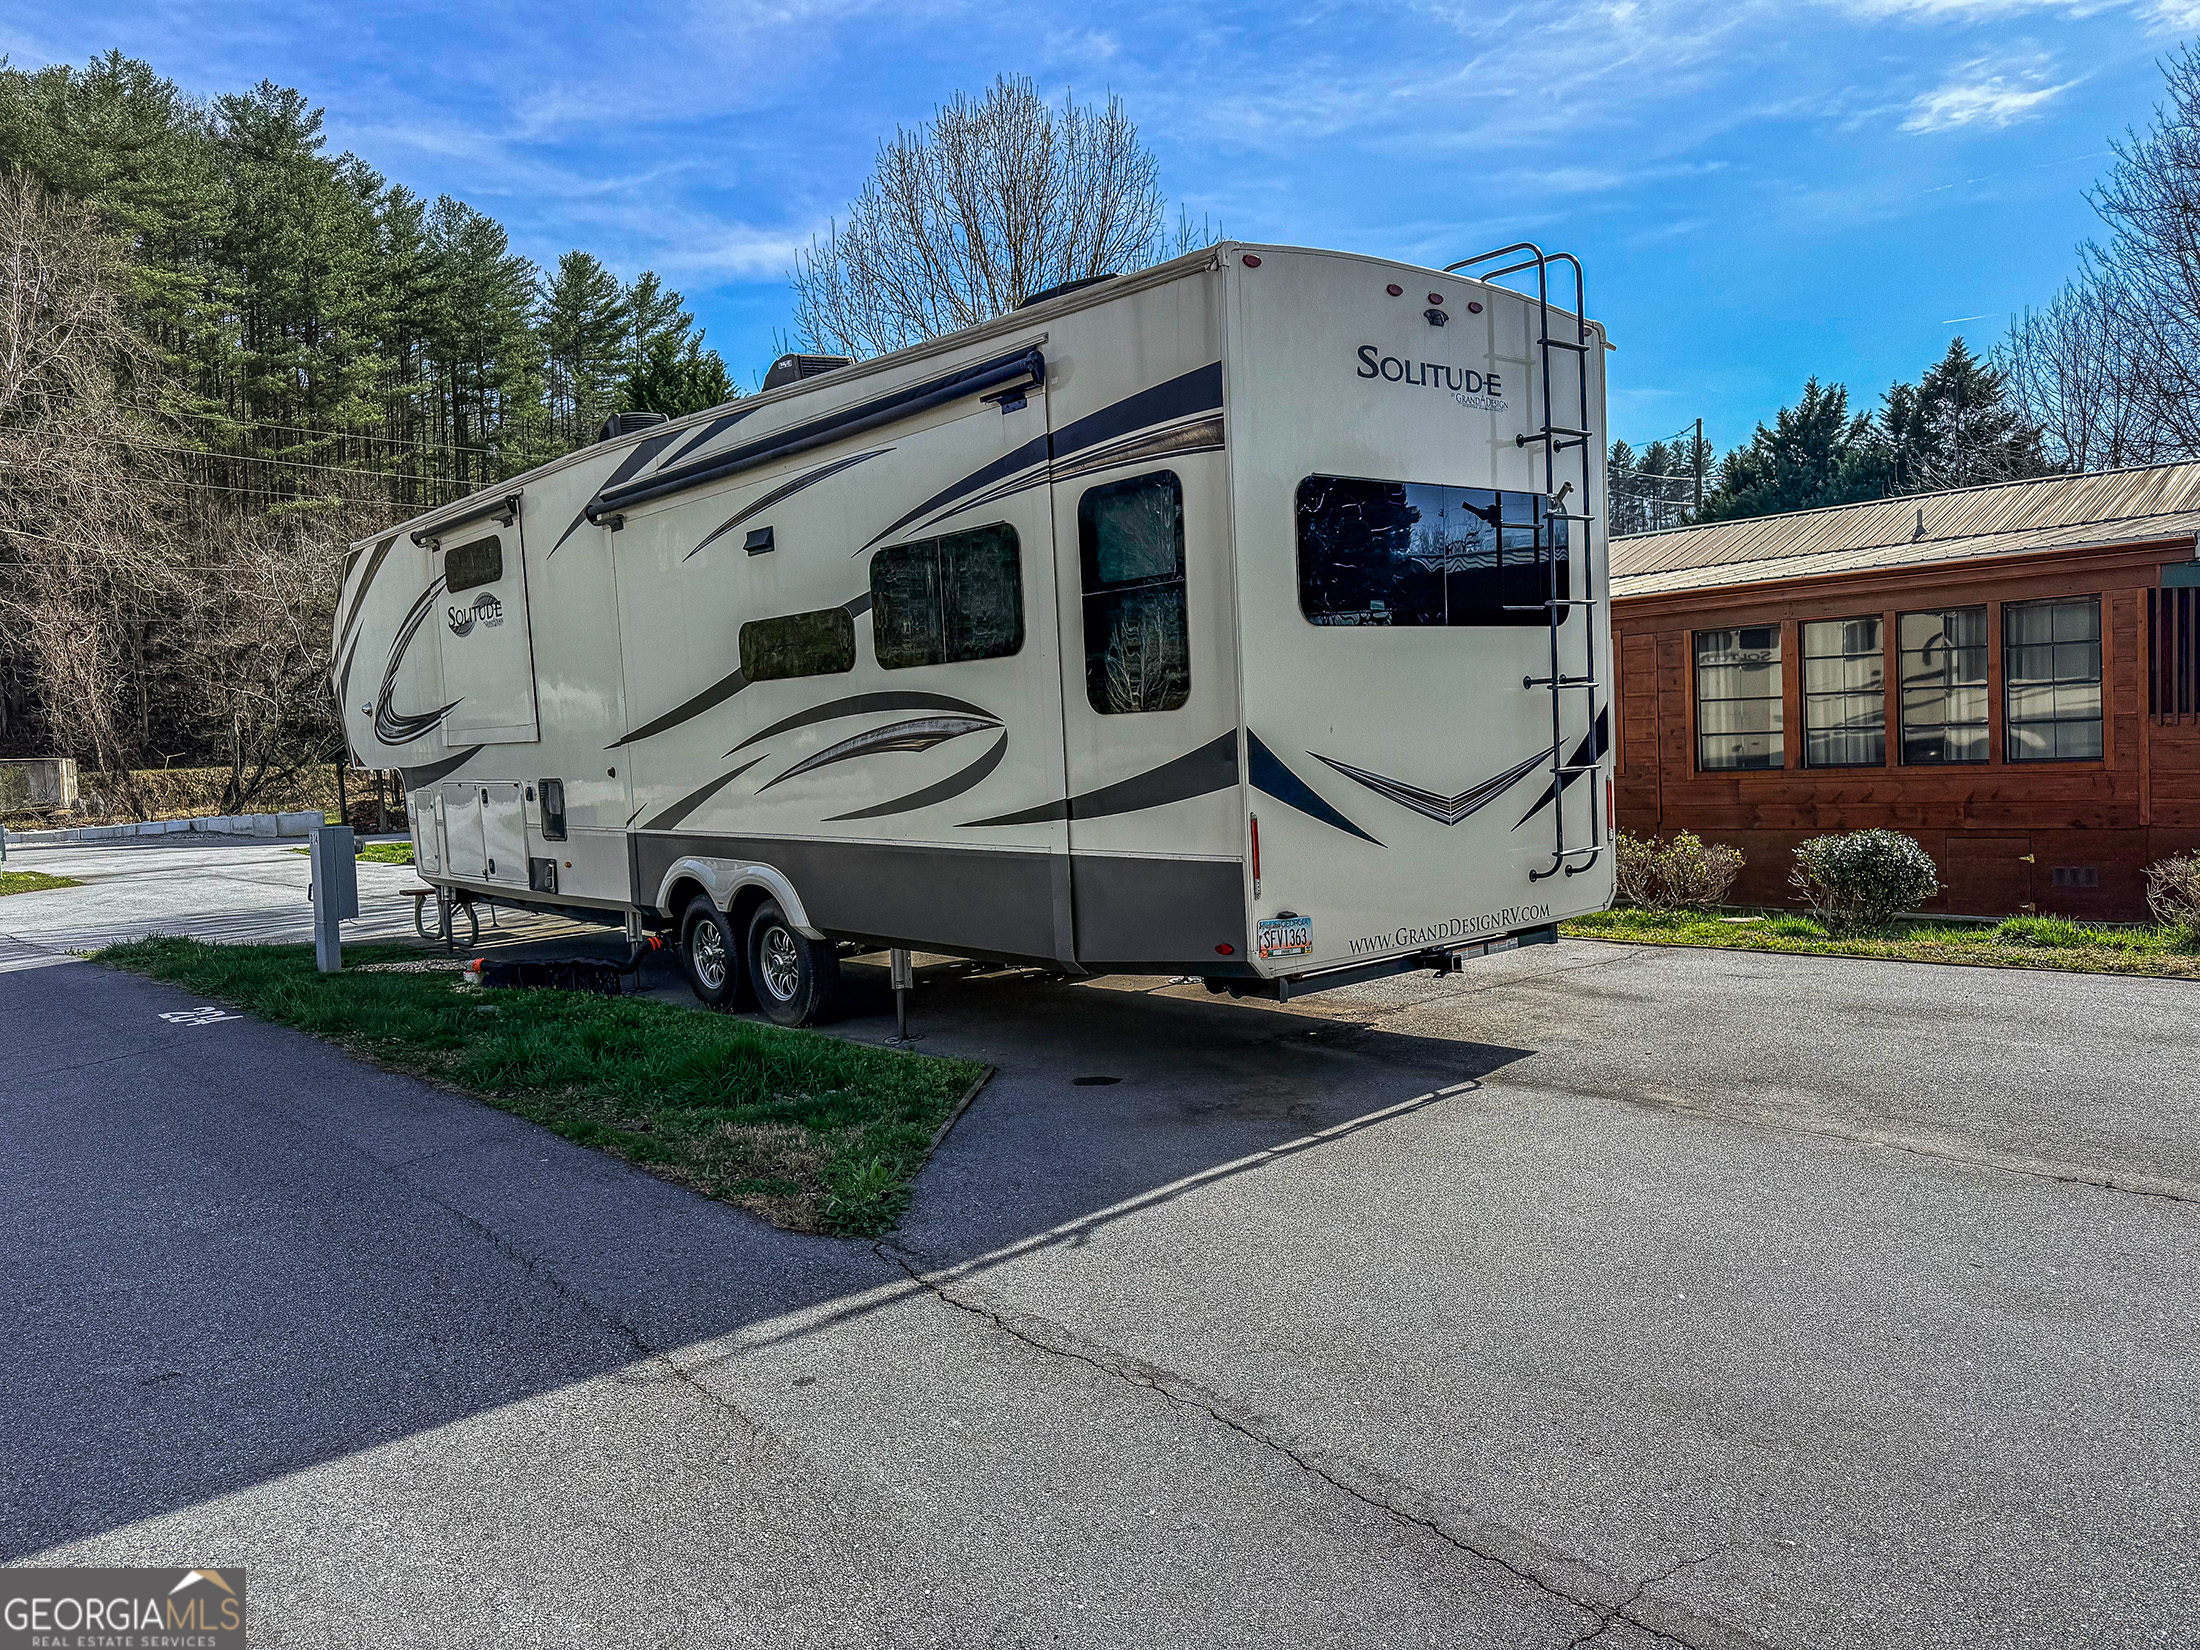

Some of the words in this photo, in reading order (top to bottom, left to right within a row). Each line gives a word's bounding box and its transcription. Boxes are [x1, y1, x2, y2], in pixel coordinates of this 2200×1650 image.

[1356, 344, 1503, 398] SOLITUDE
[447, 600, 503, 627] SOLITUDE
[1264, 927, 1307, 949] SFV1363
